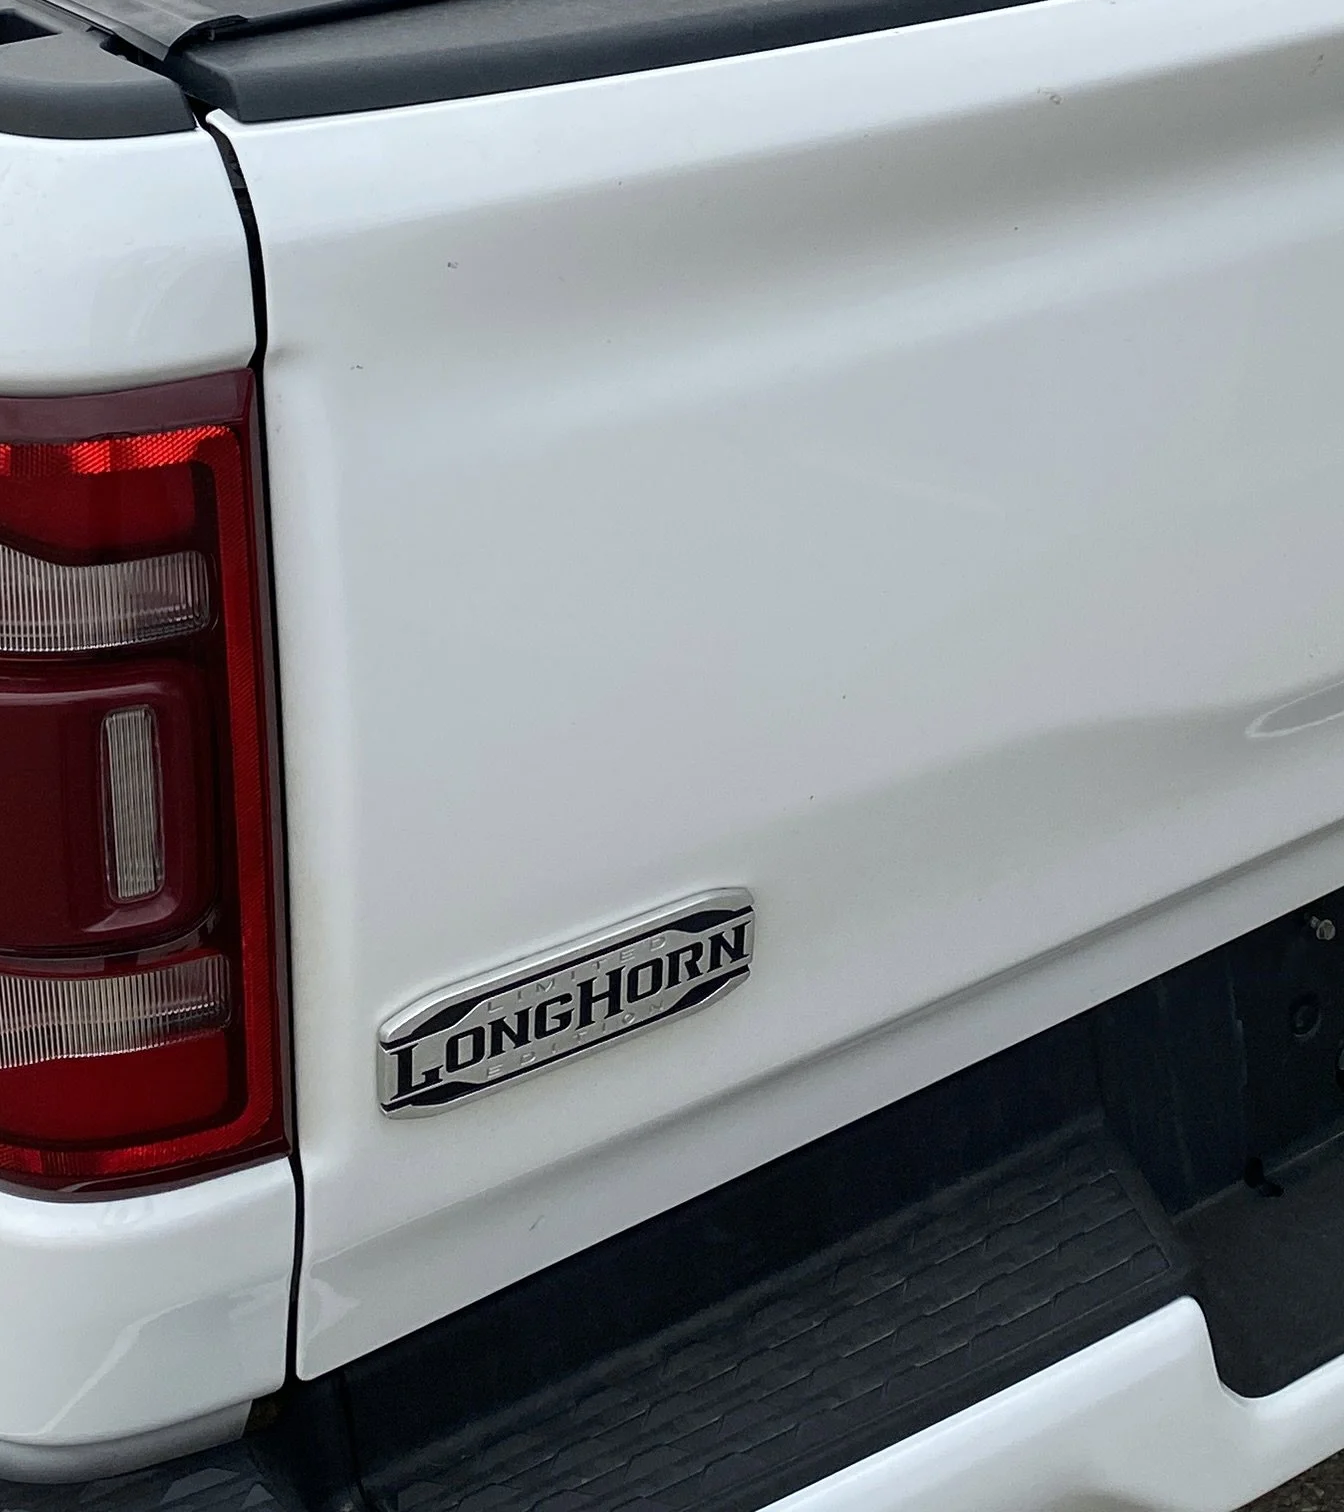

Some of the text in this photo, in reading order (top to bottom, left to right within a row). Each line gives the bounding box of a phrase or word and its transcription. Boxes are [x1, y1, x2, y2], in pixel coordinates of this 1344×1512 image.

[389, 921, 752, 1101] LONGHORN
[487, 935, 667, 1014] LIMITED
[486, 1002, 665, 1080] EDITION
